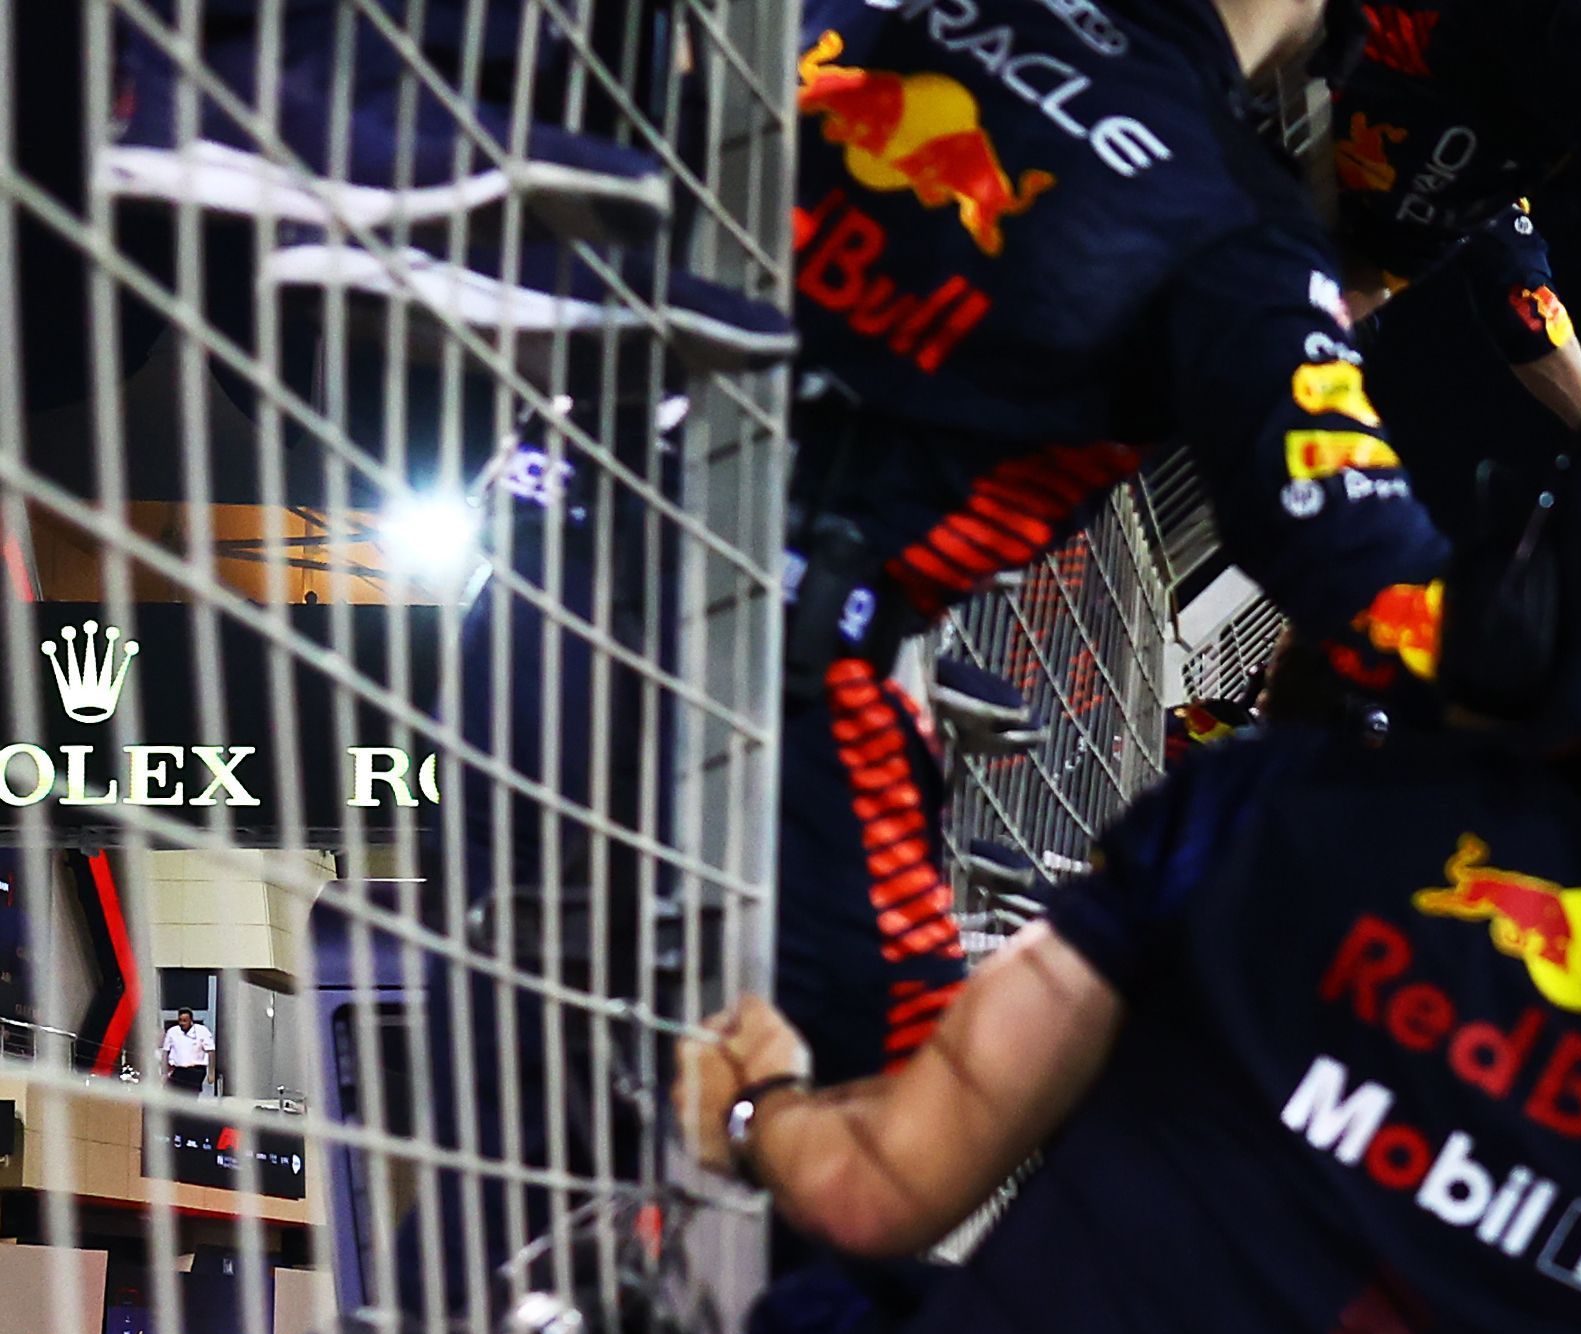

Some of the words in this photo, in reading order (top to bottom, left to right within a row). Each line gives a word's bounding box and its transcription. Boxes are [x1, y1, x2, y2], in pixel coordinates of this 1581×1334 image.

[866, 0, 1173, 178] RACLE
[0, 743, 261, 806] OLEX
[1317, 912, 1548, 1100] Red
[1280, 1053, 1558, 1258] Mobil
